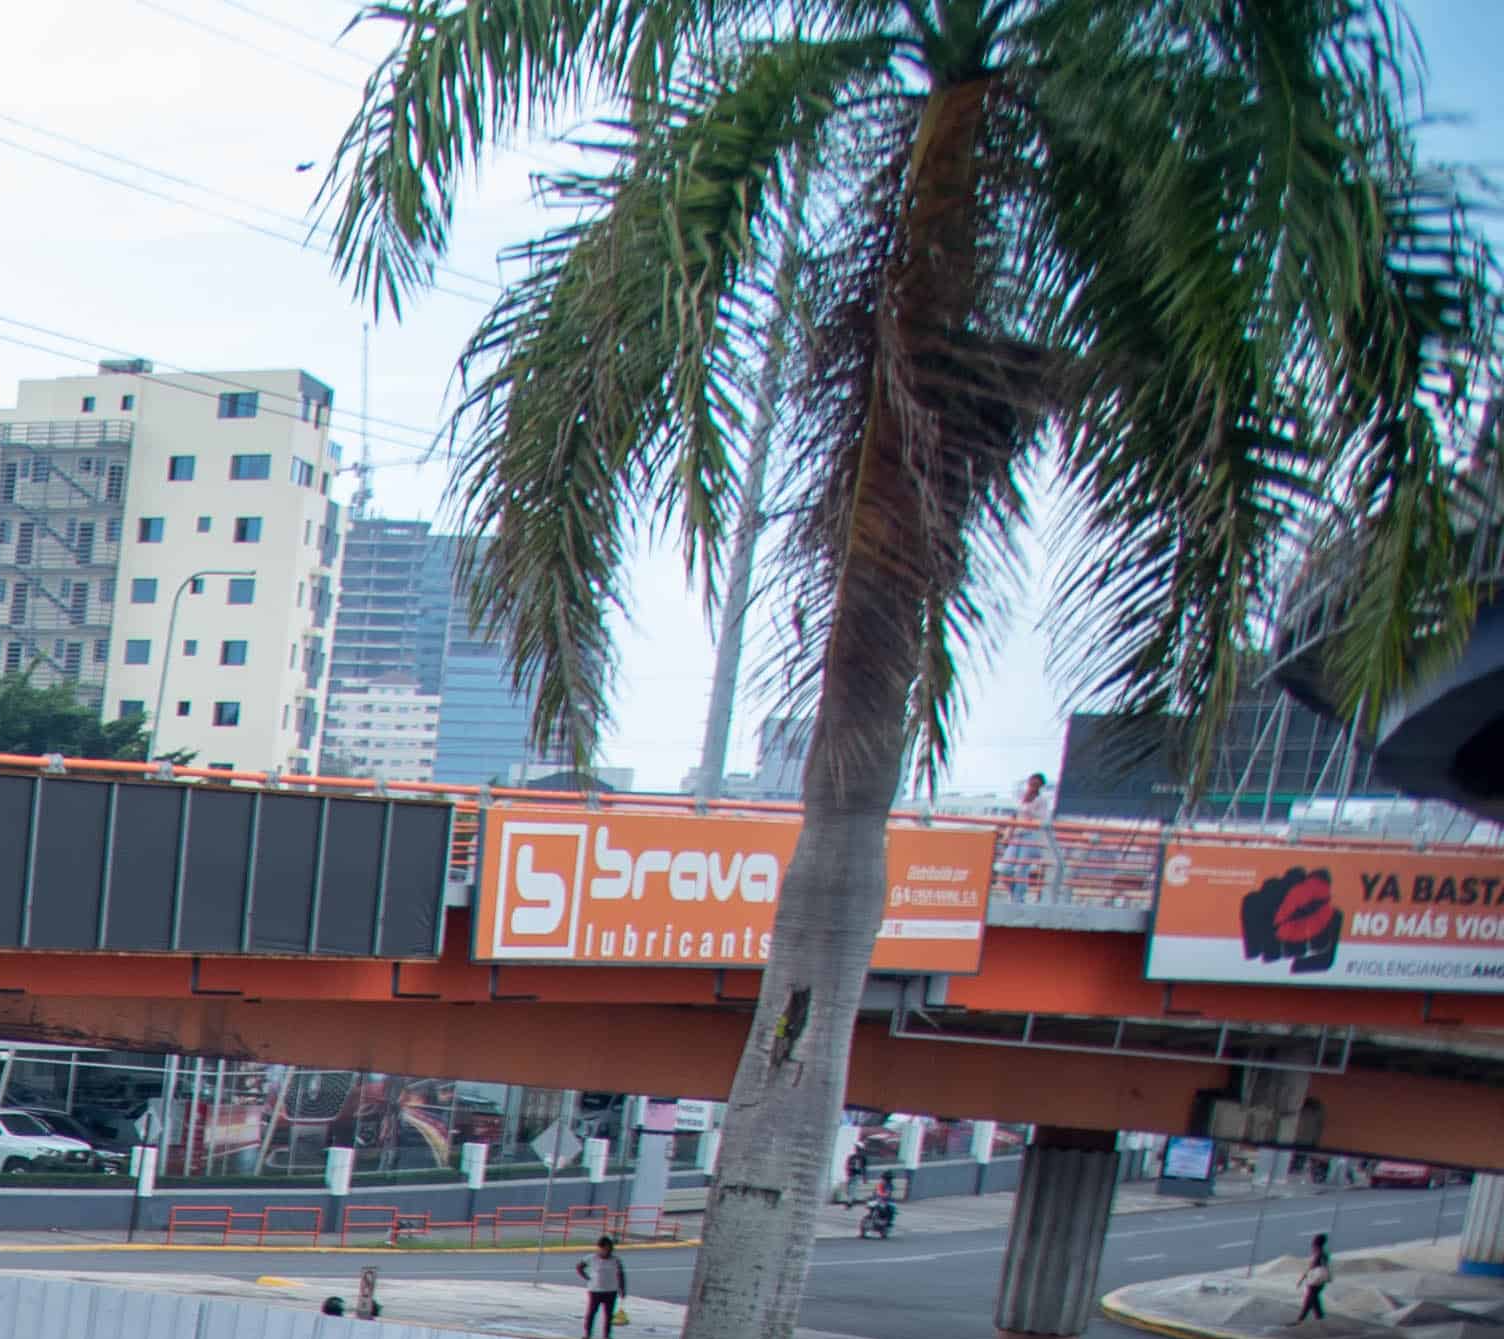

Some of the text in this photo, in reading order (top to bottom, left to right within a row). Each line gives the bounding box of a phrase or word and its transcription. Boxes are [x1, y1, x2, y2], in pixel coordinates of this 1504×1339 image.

[590, 826, 779, 902] brava
[1360, 873, 1400, 903] YA
[1350, 912, 1389, 936] NO
[1394, 907, 1449, 939] MÁS
[584, 923, 772, 958] lubricants
